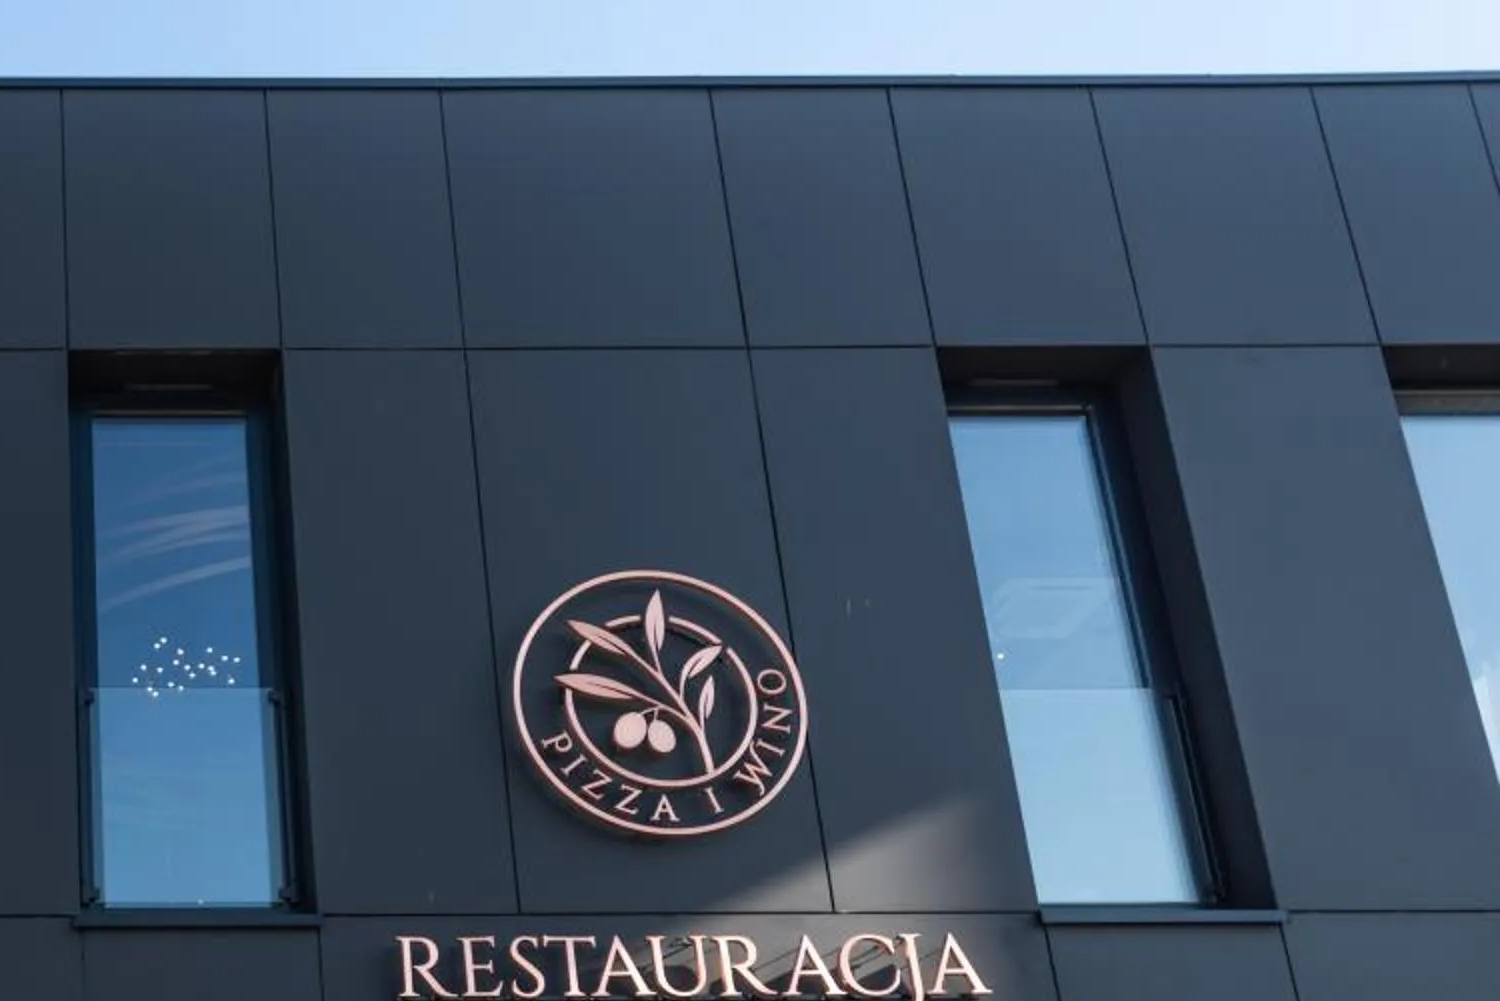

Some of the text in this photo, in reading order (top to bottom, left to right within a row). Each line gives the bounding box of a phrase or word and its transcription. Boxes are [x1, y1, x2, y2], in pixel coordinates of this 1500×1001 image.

[541, 668, 793, 822] PIZZA I WINO
